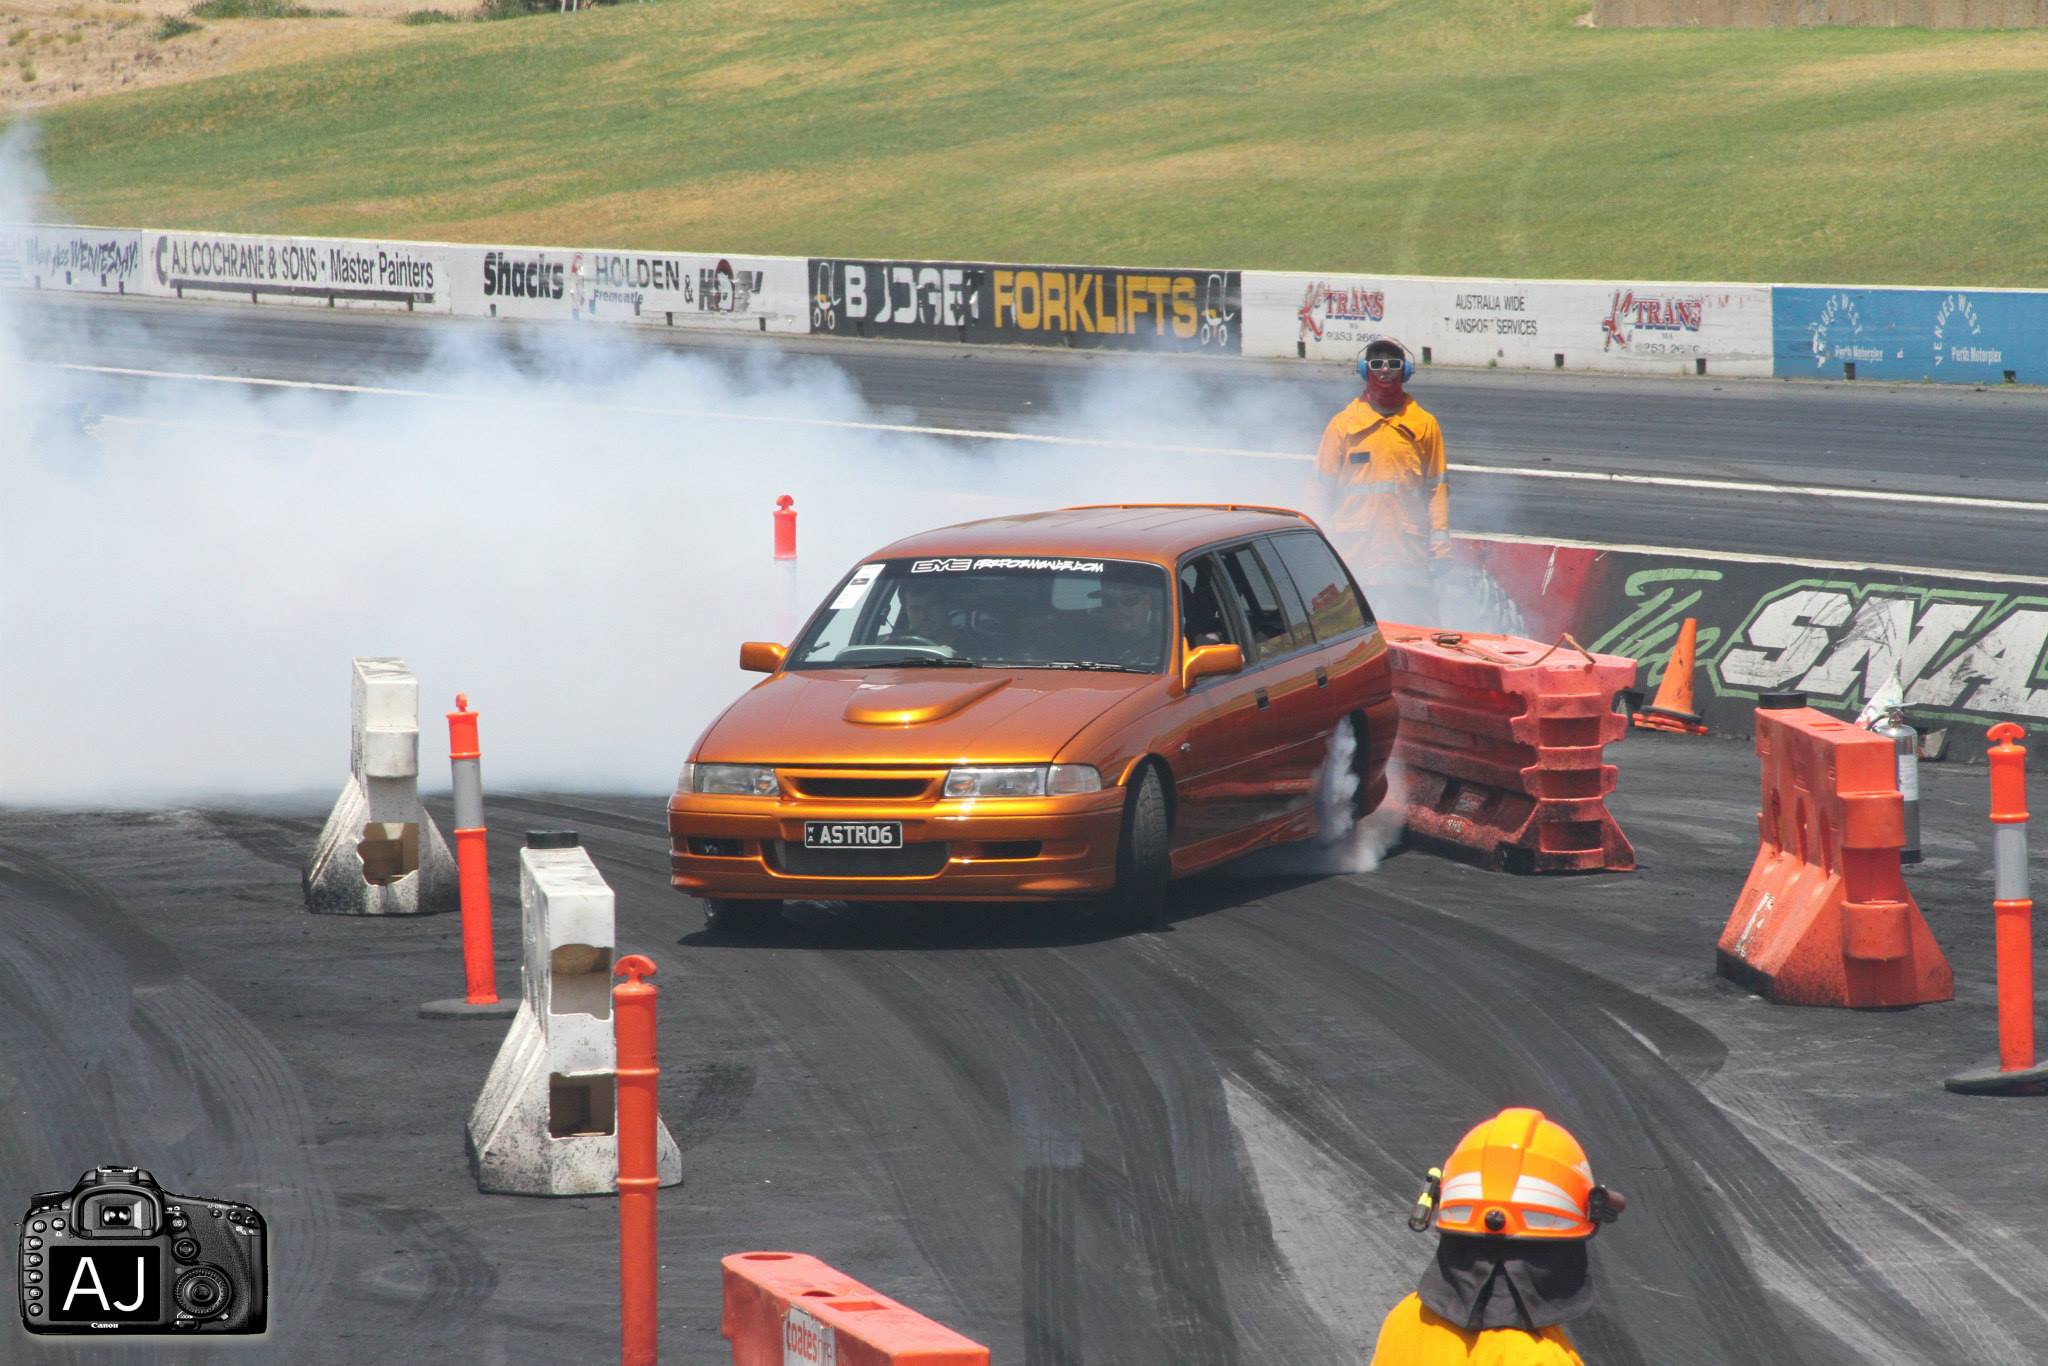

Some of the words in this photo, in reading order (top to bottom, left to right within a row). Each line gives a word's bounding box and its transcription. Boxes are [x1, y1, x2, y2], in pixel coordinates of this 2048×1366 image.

[191, 241, 265, 279] COCHRANE
[269, 246, 277, 280] &
[282, 245, 317, 281] SONS
[330, 248, 374, 285] Master
[378, 251, 434, 288] Painters
[483, 252, 564, 300] Shacks
[595, 256, 680, 291] HOLDEN
[684, 274, 694, 304] &
[993, 270, 1197, 338] FORKLIFTS
[1455, 294, 1500, 310] AUSTRALIA
[1503, 295, 1525, 311] WIDE
[1496, 318, 1537, 336] SERVICES
[1716, 586, 2048, 720] SNA
